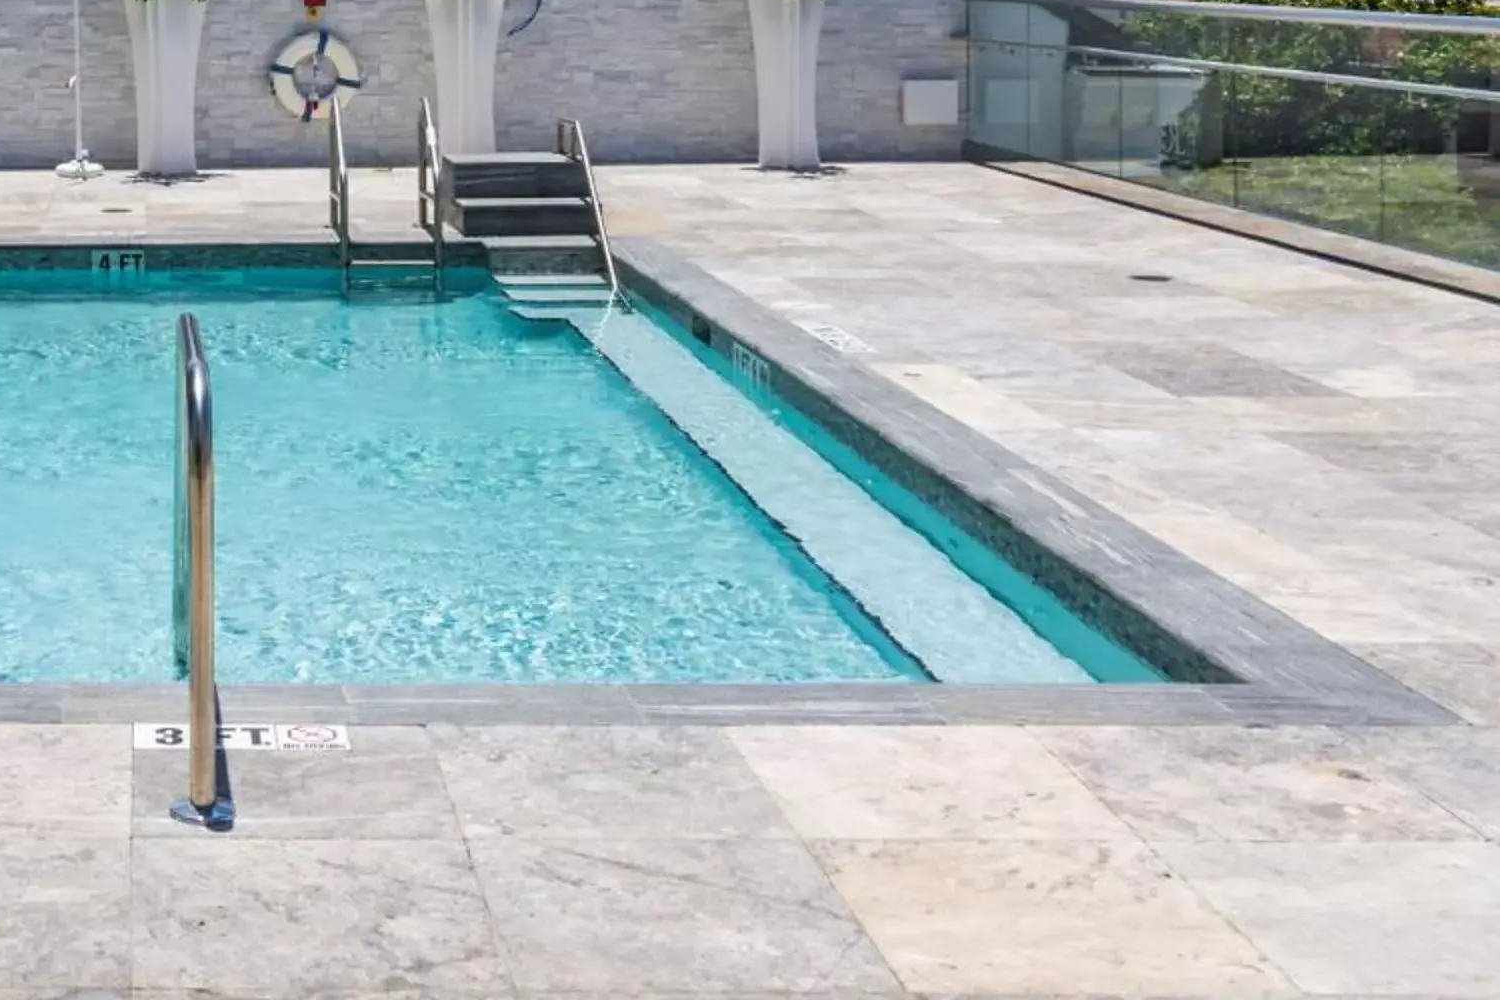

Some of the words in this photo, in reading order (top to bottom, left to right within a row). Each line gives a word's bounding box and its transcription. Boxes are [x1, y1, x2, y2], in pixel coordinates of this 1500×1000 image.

[99, 253, 113, 271] 4
[119, 253, 143, 271] FT
[155, 727, 184, 746] 3
